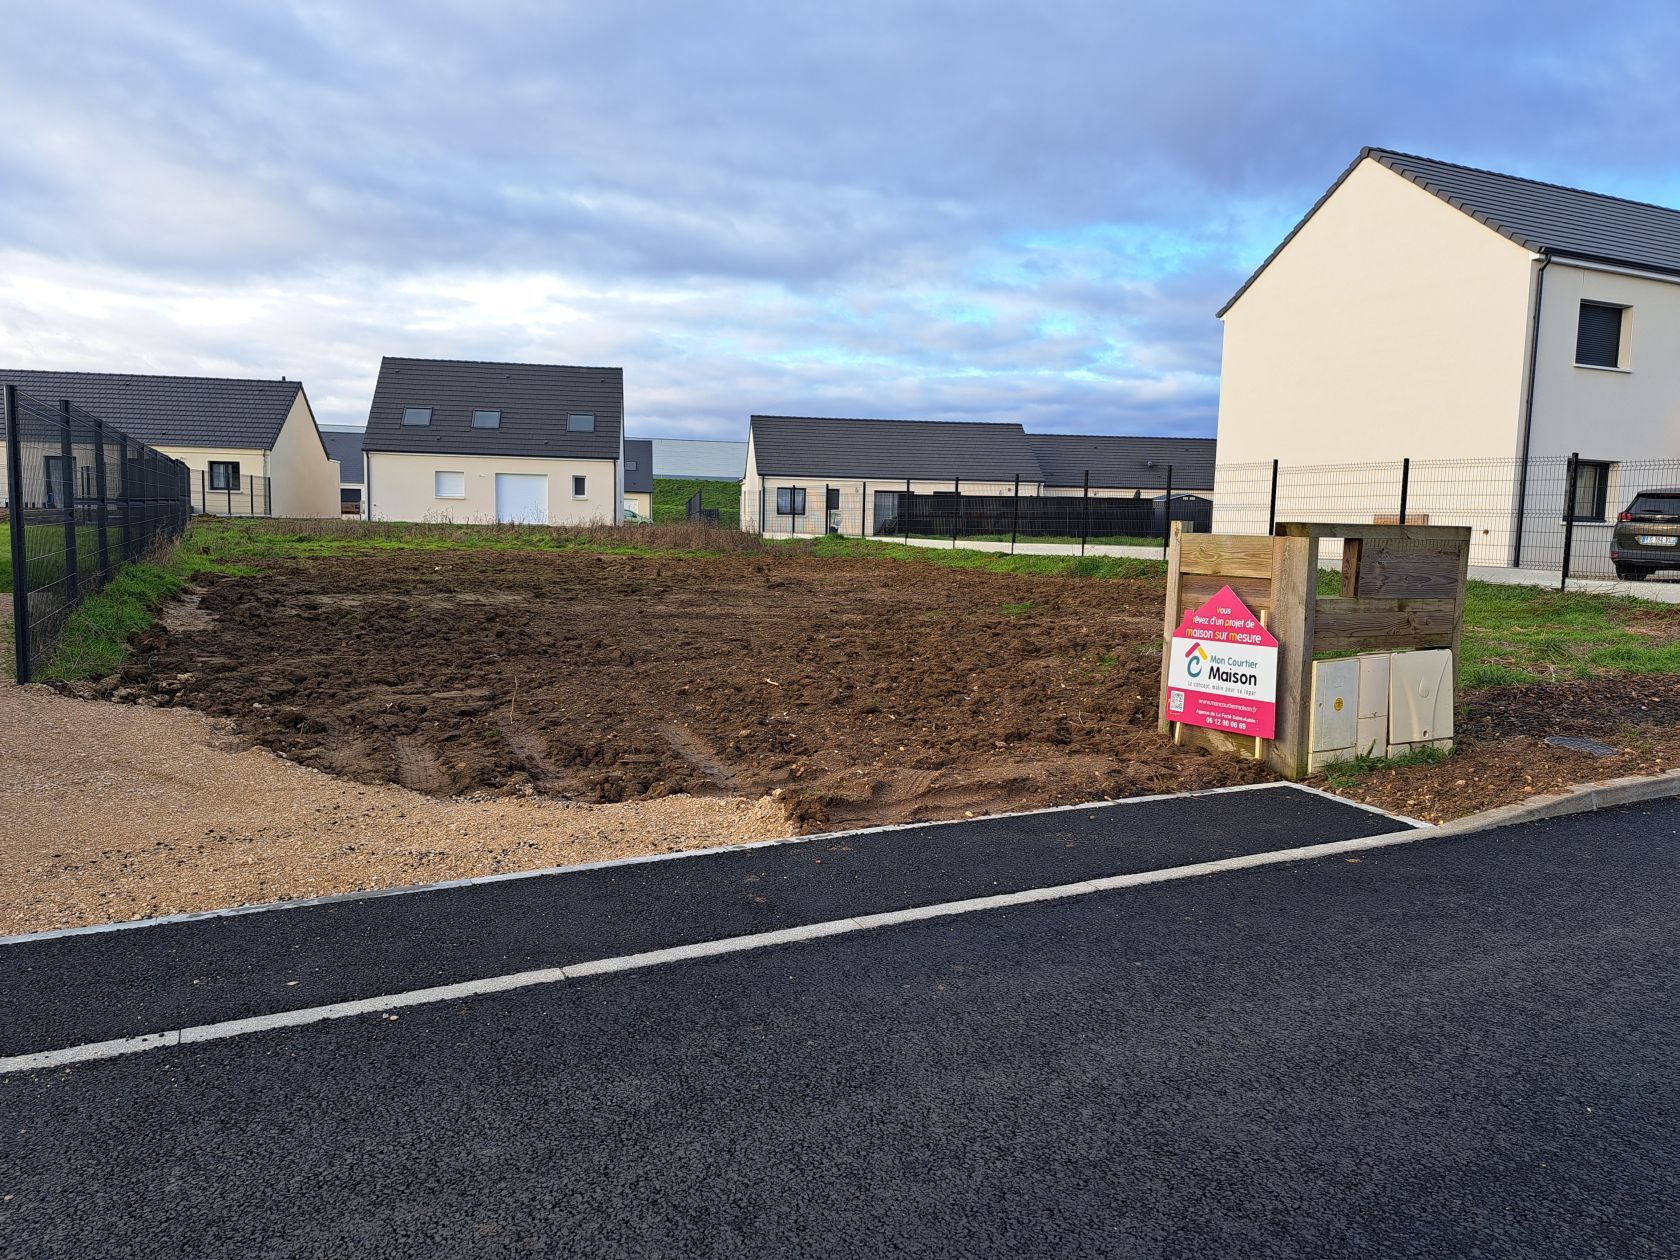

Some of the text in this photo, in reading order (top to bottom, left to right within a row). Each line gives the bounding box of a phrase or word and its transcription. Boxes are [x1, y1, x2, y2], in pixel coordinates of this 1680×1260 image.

[1217, 606, 1231, 614] Vous
[1193, 616, 1255, 629] rêvez d'un projet de
[1186, 628, 1261, 643] maison sur mesure
[1210, 655, 1258, 669] Mon Courtier
[1209, 666, 1257, 686] Maison
